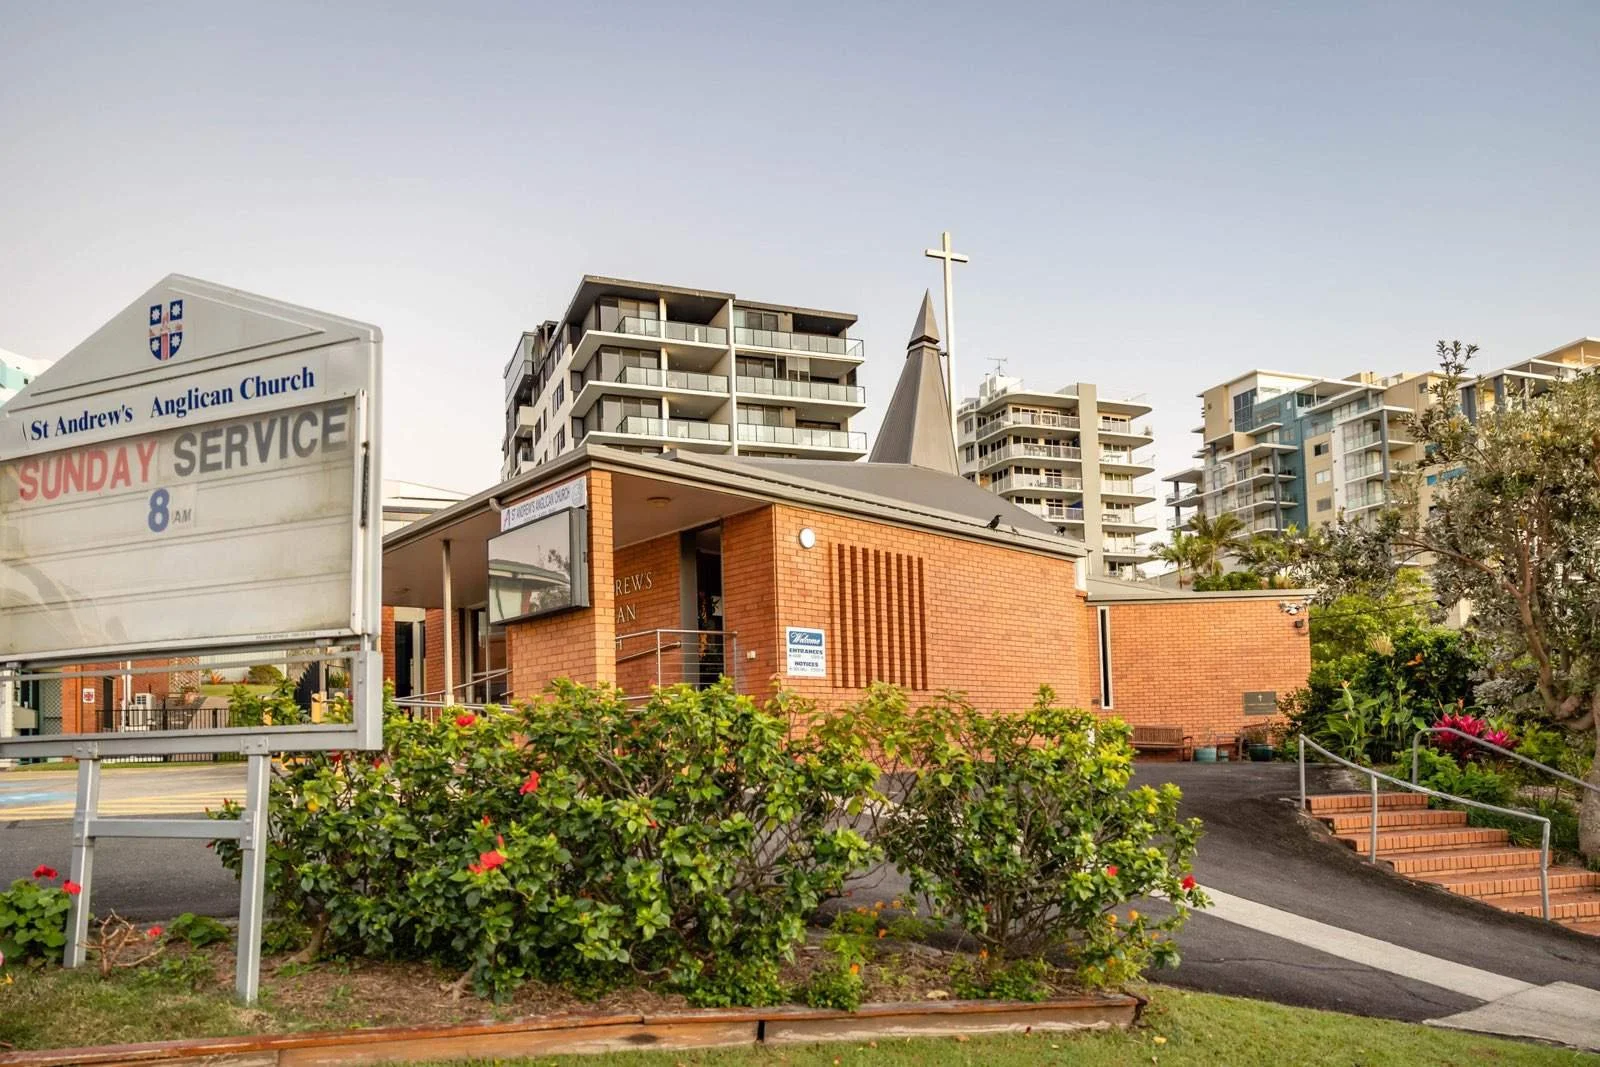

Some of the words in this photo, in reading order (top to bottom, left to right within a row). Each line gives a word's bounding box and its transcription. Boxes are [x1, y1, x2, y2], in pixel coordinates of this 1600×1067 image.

[31, 420, 48, 441] St
[55, 404, 133, 437] Andrew's
[150, 383, 234, 419] Anglican
[240, 366, 315, 401] Church
[19, 440, 157, 501] SUNDAY
[173, 405, 349, 477] SERVICE
[536, 493, 554, 511] ANGLICAN
[555, 487, 570, 504] CHURCH
